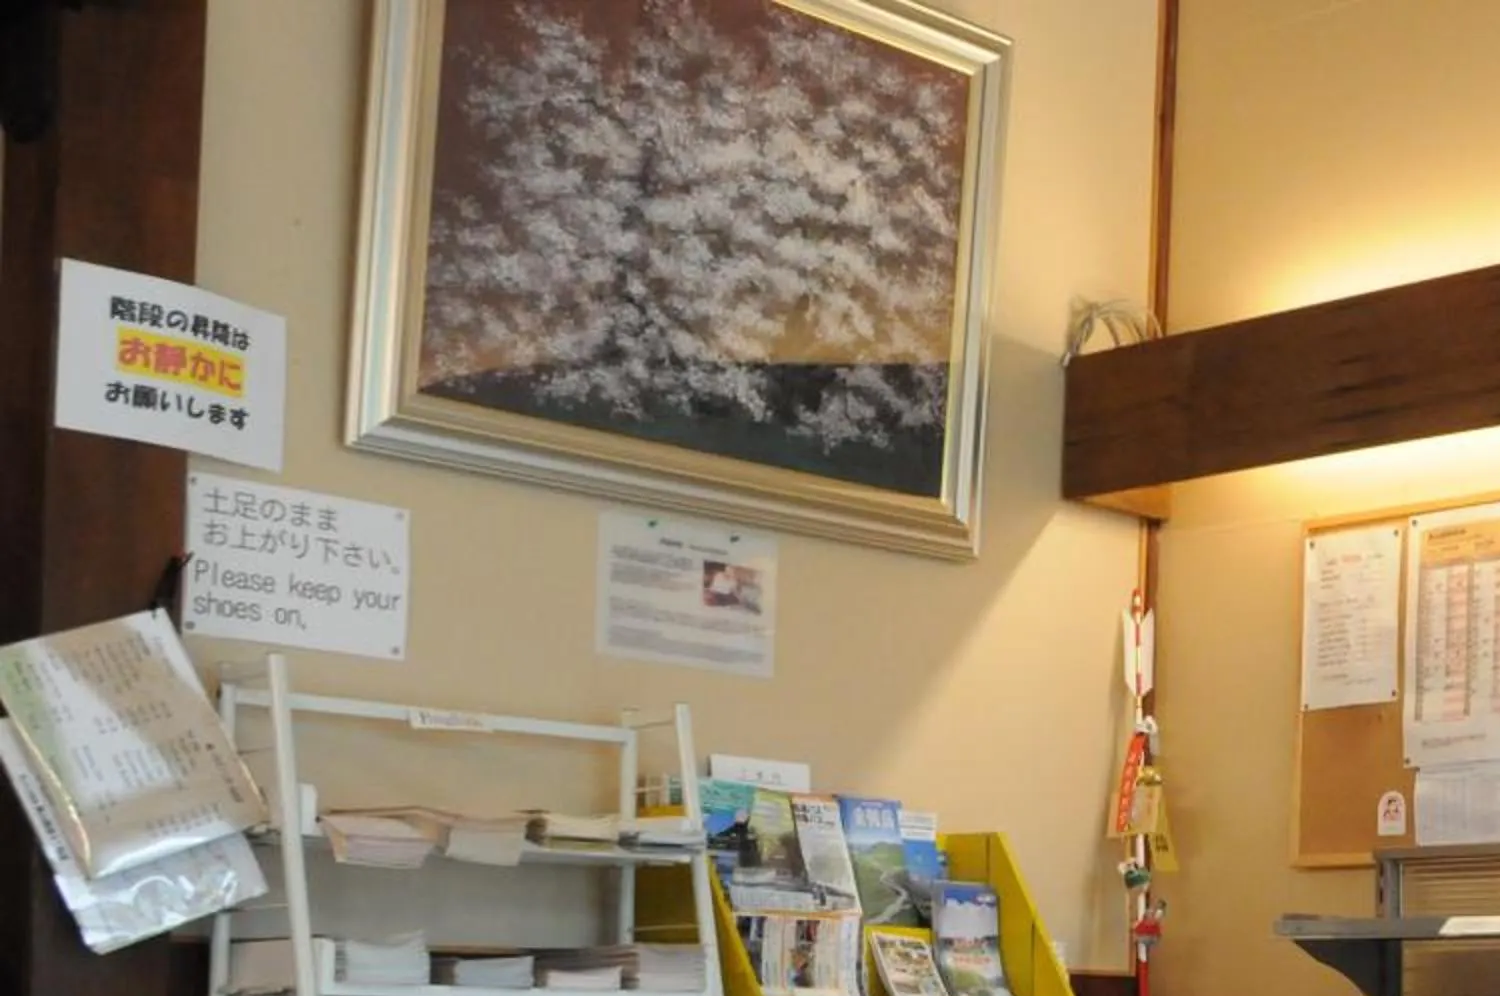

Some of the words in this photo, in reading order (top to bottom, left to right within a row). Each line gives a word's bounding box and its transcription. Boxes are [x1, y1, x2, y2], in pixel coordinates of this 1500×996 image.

[110, 296, 250, 351] 階段の昇降は
[117, 336, 243, 392] お静かに
[105, 381, 250, 431] お願いします
[203, 488, 338, 532] 土足のまま
[203, 521, 401, 576] お上がり下さい。
[193, 593, 262, 624] shoes
[194, 559, 276, 594] Please
[288, 573, 342, 606] keep
[353, 587, 400, 611] your
